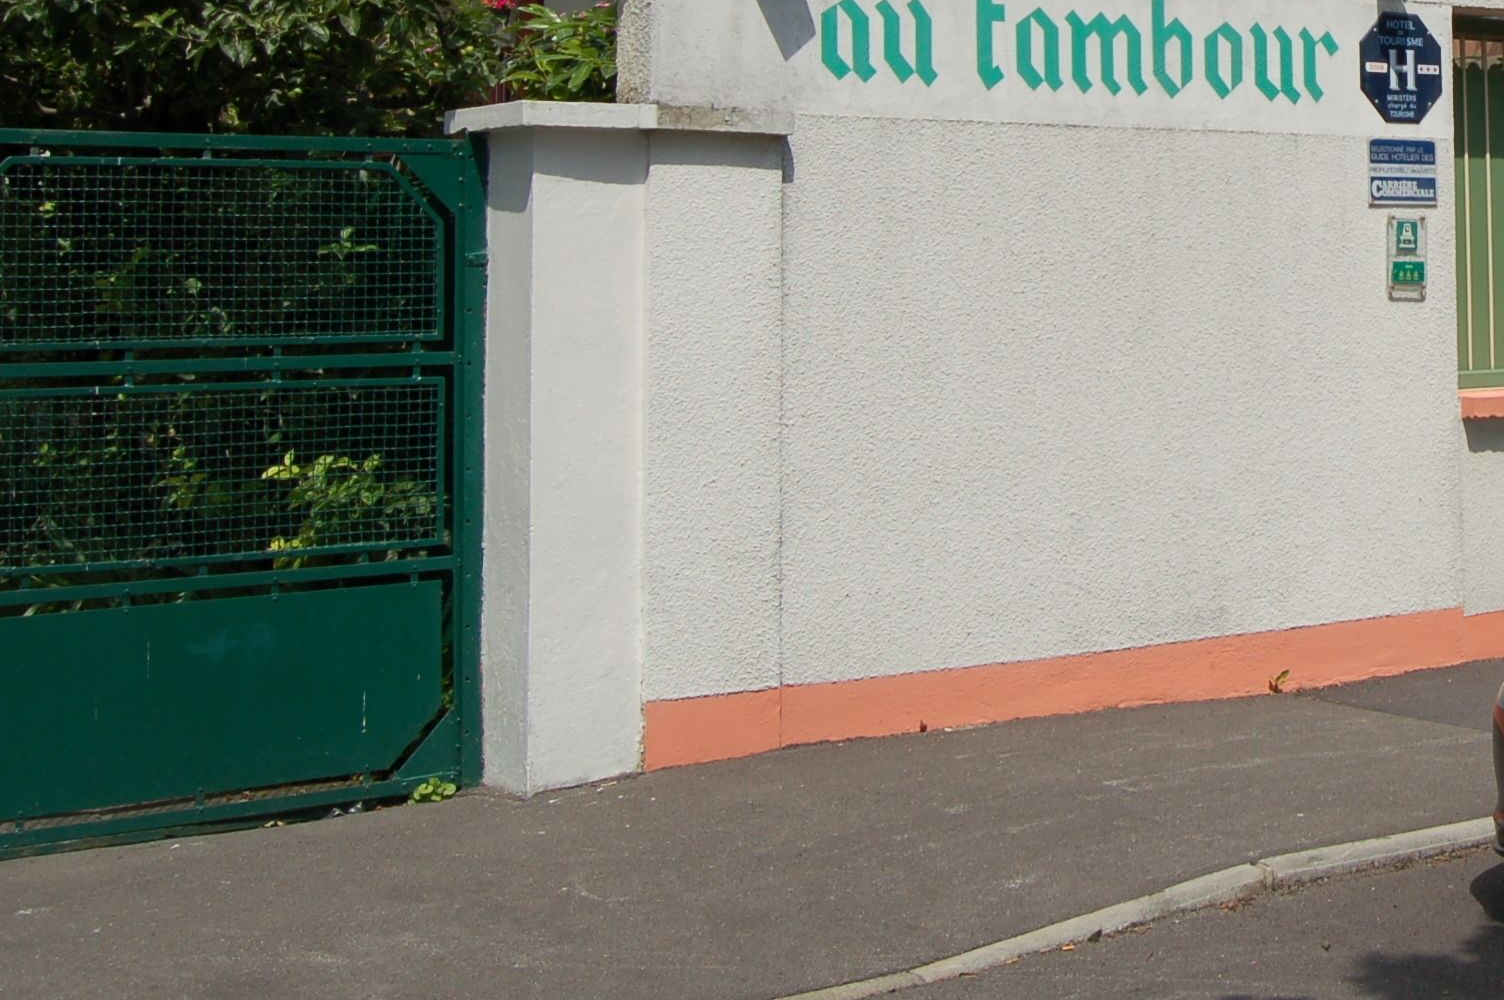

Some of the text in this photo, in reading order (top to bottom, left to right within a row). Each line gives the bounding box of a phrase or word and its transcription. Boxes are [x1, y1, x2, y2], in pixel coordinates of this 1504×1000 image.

[1386, 19, 1415, 30] HOTEL
[1378, 35, 1424, 47] TOURISME
[1389, 49, 1418, 91] H
